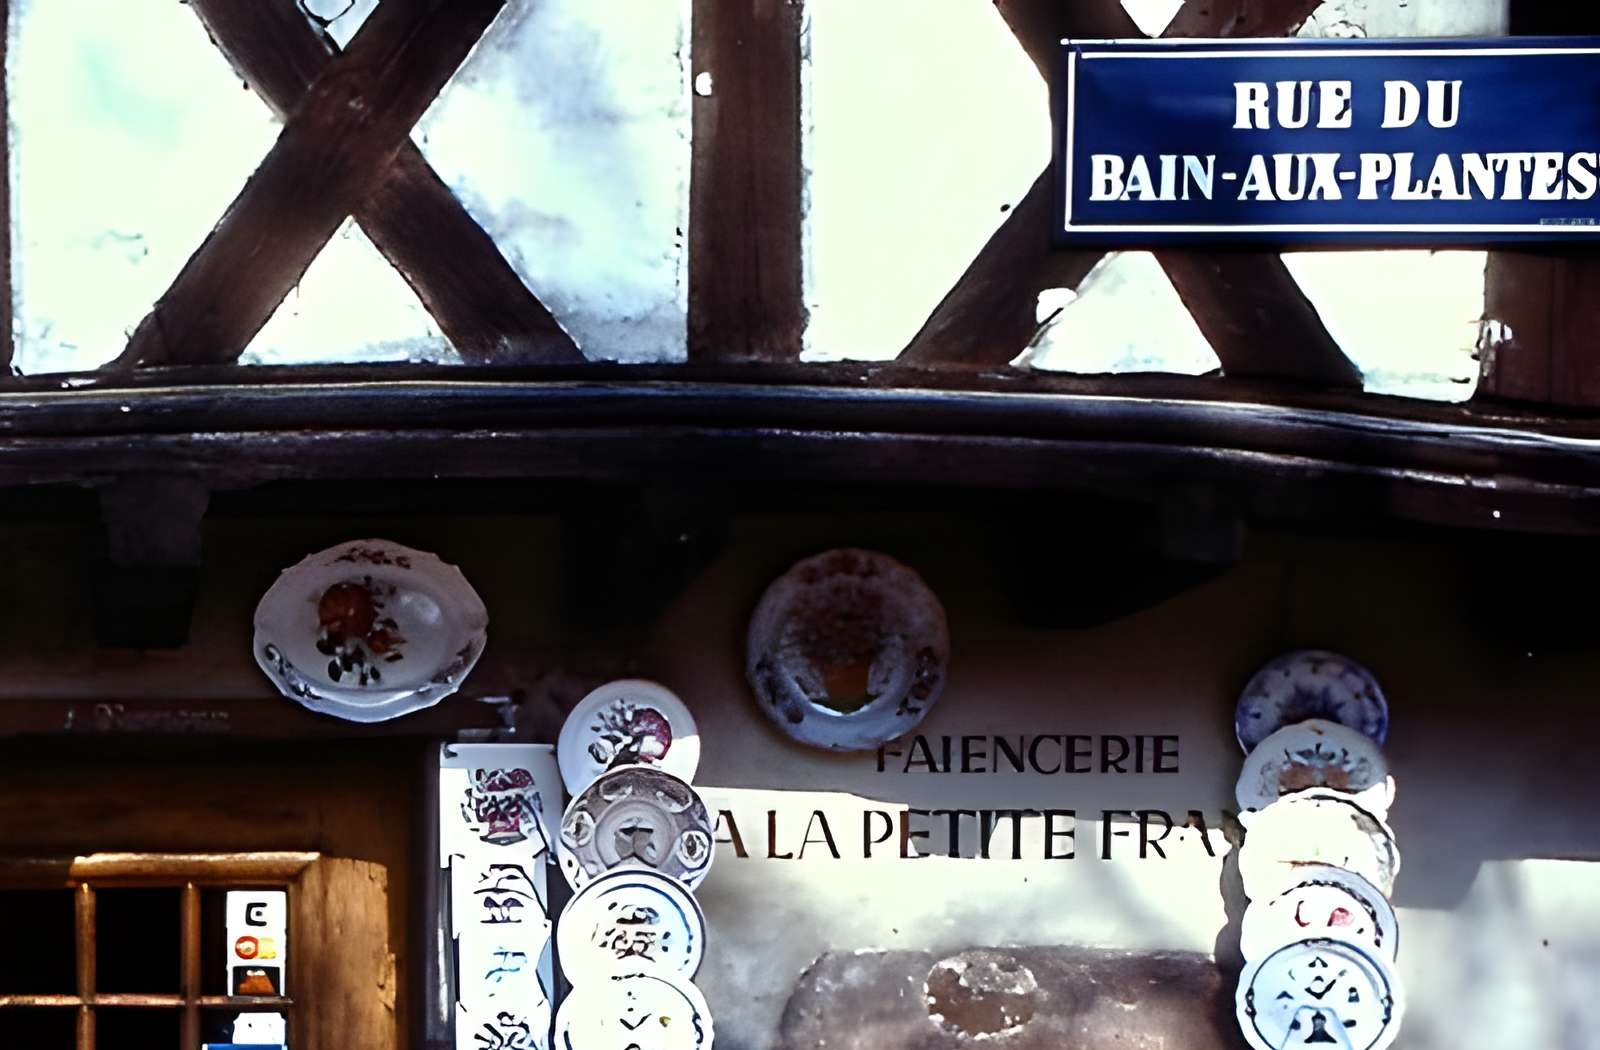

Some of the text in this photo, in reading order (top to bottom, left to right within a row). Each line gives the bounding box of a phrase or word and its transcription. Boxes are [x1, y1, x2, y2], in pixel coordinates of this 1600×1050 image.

[1232, 80, 1463, 130] RUE DU
[1090, 151, 1598, 201] BAIN-AUX-PLANTES
[875, 733, 1180, 775] FAIENCERIE
[713, 808, 1218, 861] A LA PETITE FRA
